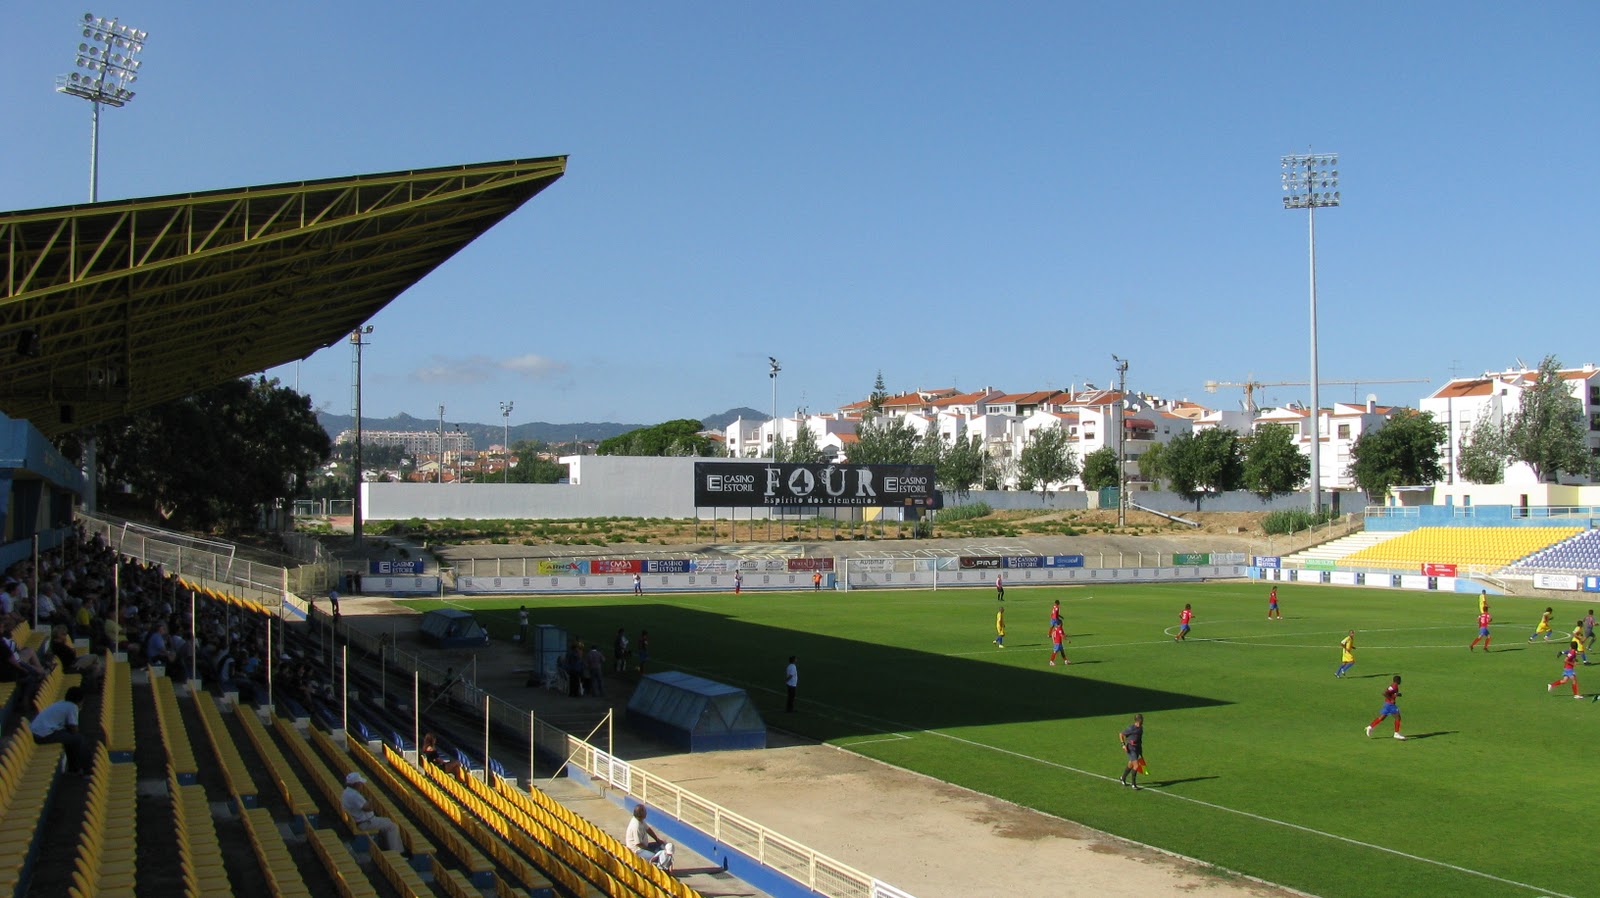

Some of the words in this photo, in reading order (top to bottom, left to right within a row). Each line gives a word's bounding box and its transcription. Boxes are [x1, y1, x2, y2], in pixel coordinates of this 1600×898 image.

[724, 475, 754, 483] CASINO
[900, 477, 927, 485] CASINO
[724, 484, 754, 492] ESTORIL
[900, 485, 927, 493] ESTORIL
[764, 496, 803, 505] Espírito
[808, 496, 824, 504] dos
[828, 496, 876, 504] elementos
